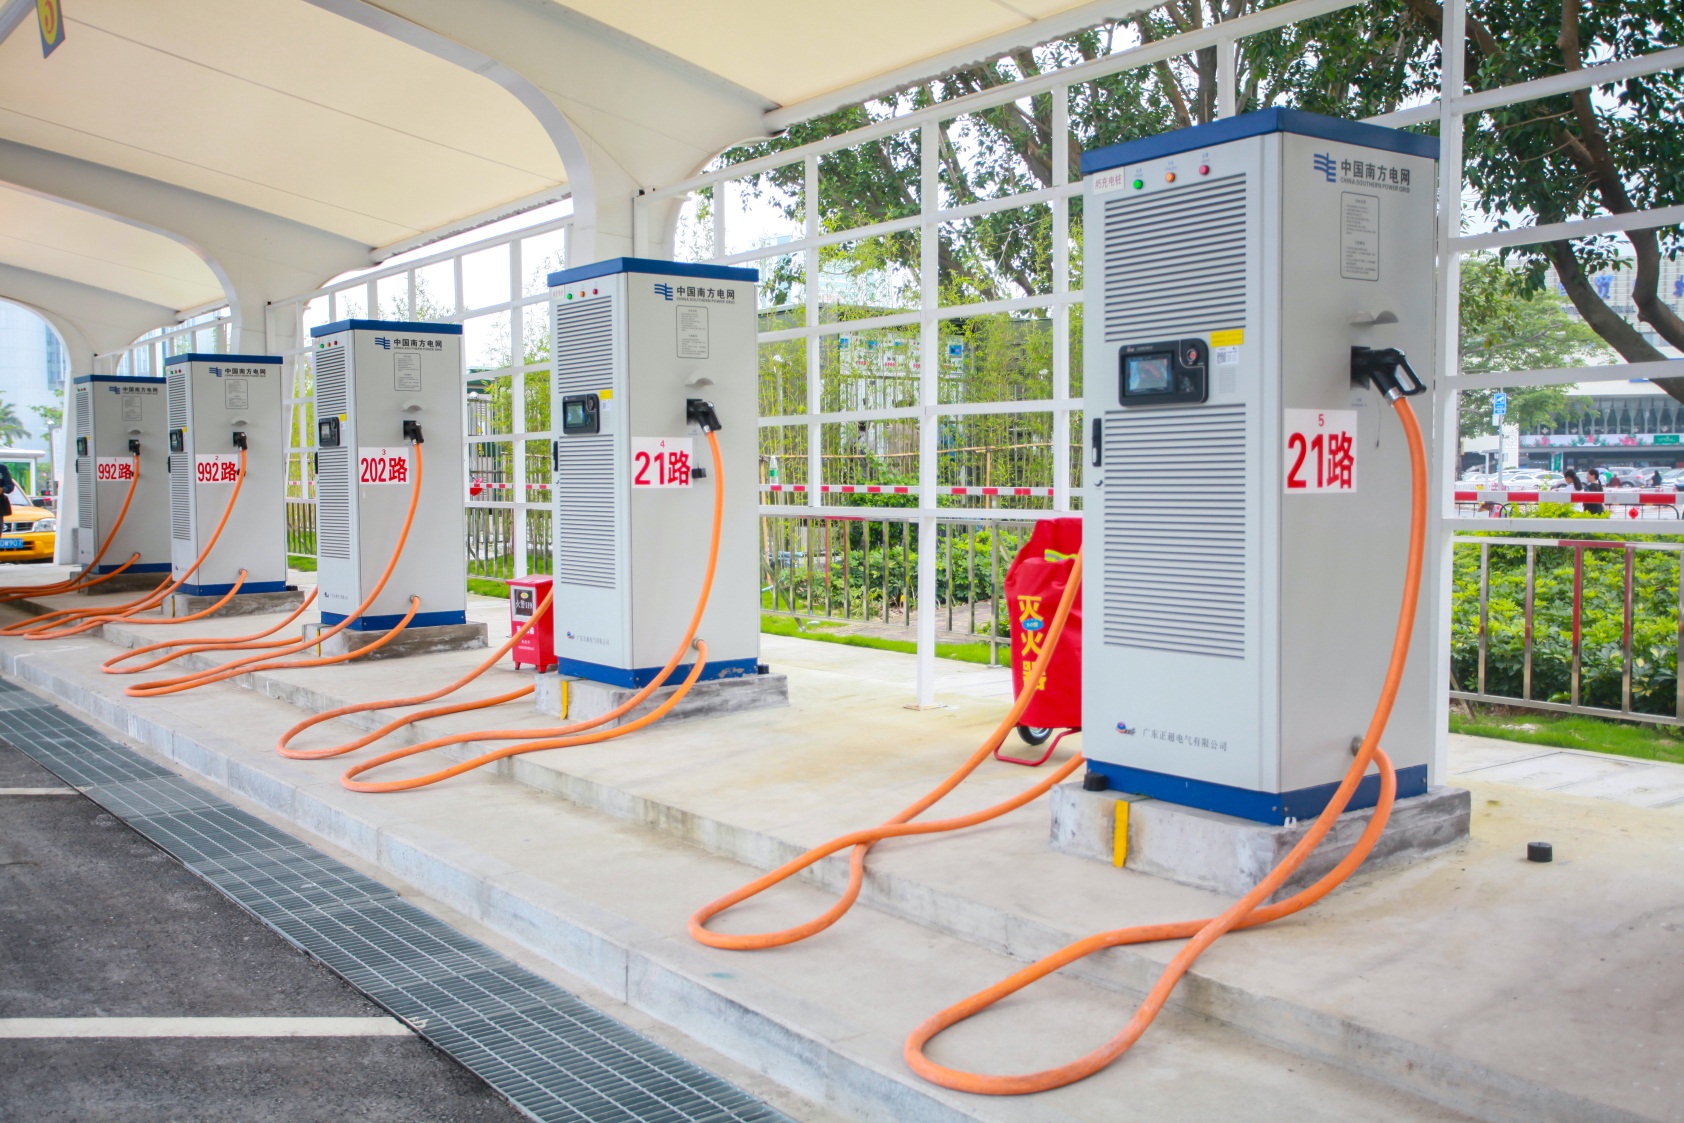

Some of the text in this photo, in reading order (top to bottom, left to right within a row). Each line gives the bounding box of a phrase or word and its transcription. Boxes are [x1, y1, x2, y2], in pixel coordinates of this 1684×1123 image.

[1341, 158, 1410, 186] 中国南方电网
[1340, 176, 1355, 185] CHINA
[1356, 179, 1381, 189] SOUTHERN
[1382, 183, 1399, 191] POWER
[676, 286, 735, 300] 中国南方电网
[393, 338, 443, 349] 中国南方电网
[224, 367, 266, 375] 中国南方电网
[1318, 413, 1324, 427] 5
[660, 440, 665, 448] 4
[634, 450, 691, 486] 21路
[1286, 430, 1355, 490] 21路
[98, 463, 133, 480] 992路
[197, 461, 237, 482] 992路
[360, 456, 408, 483] 202路
